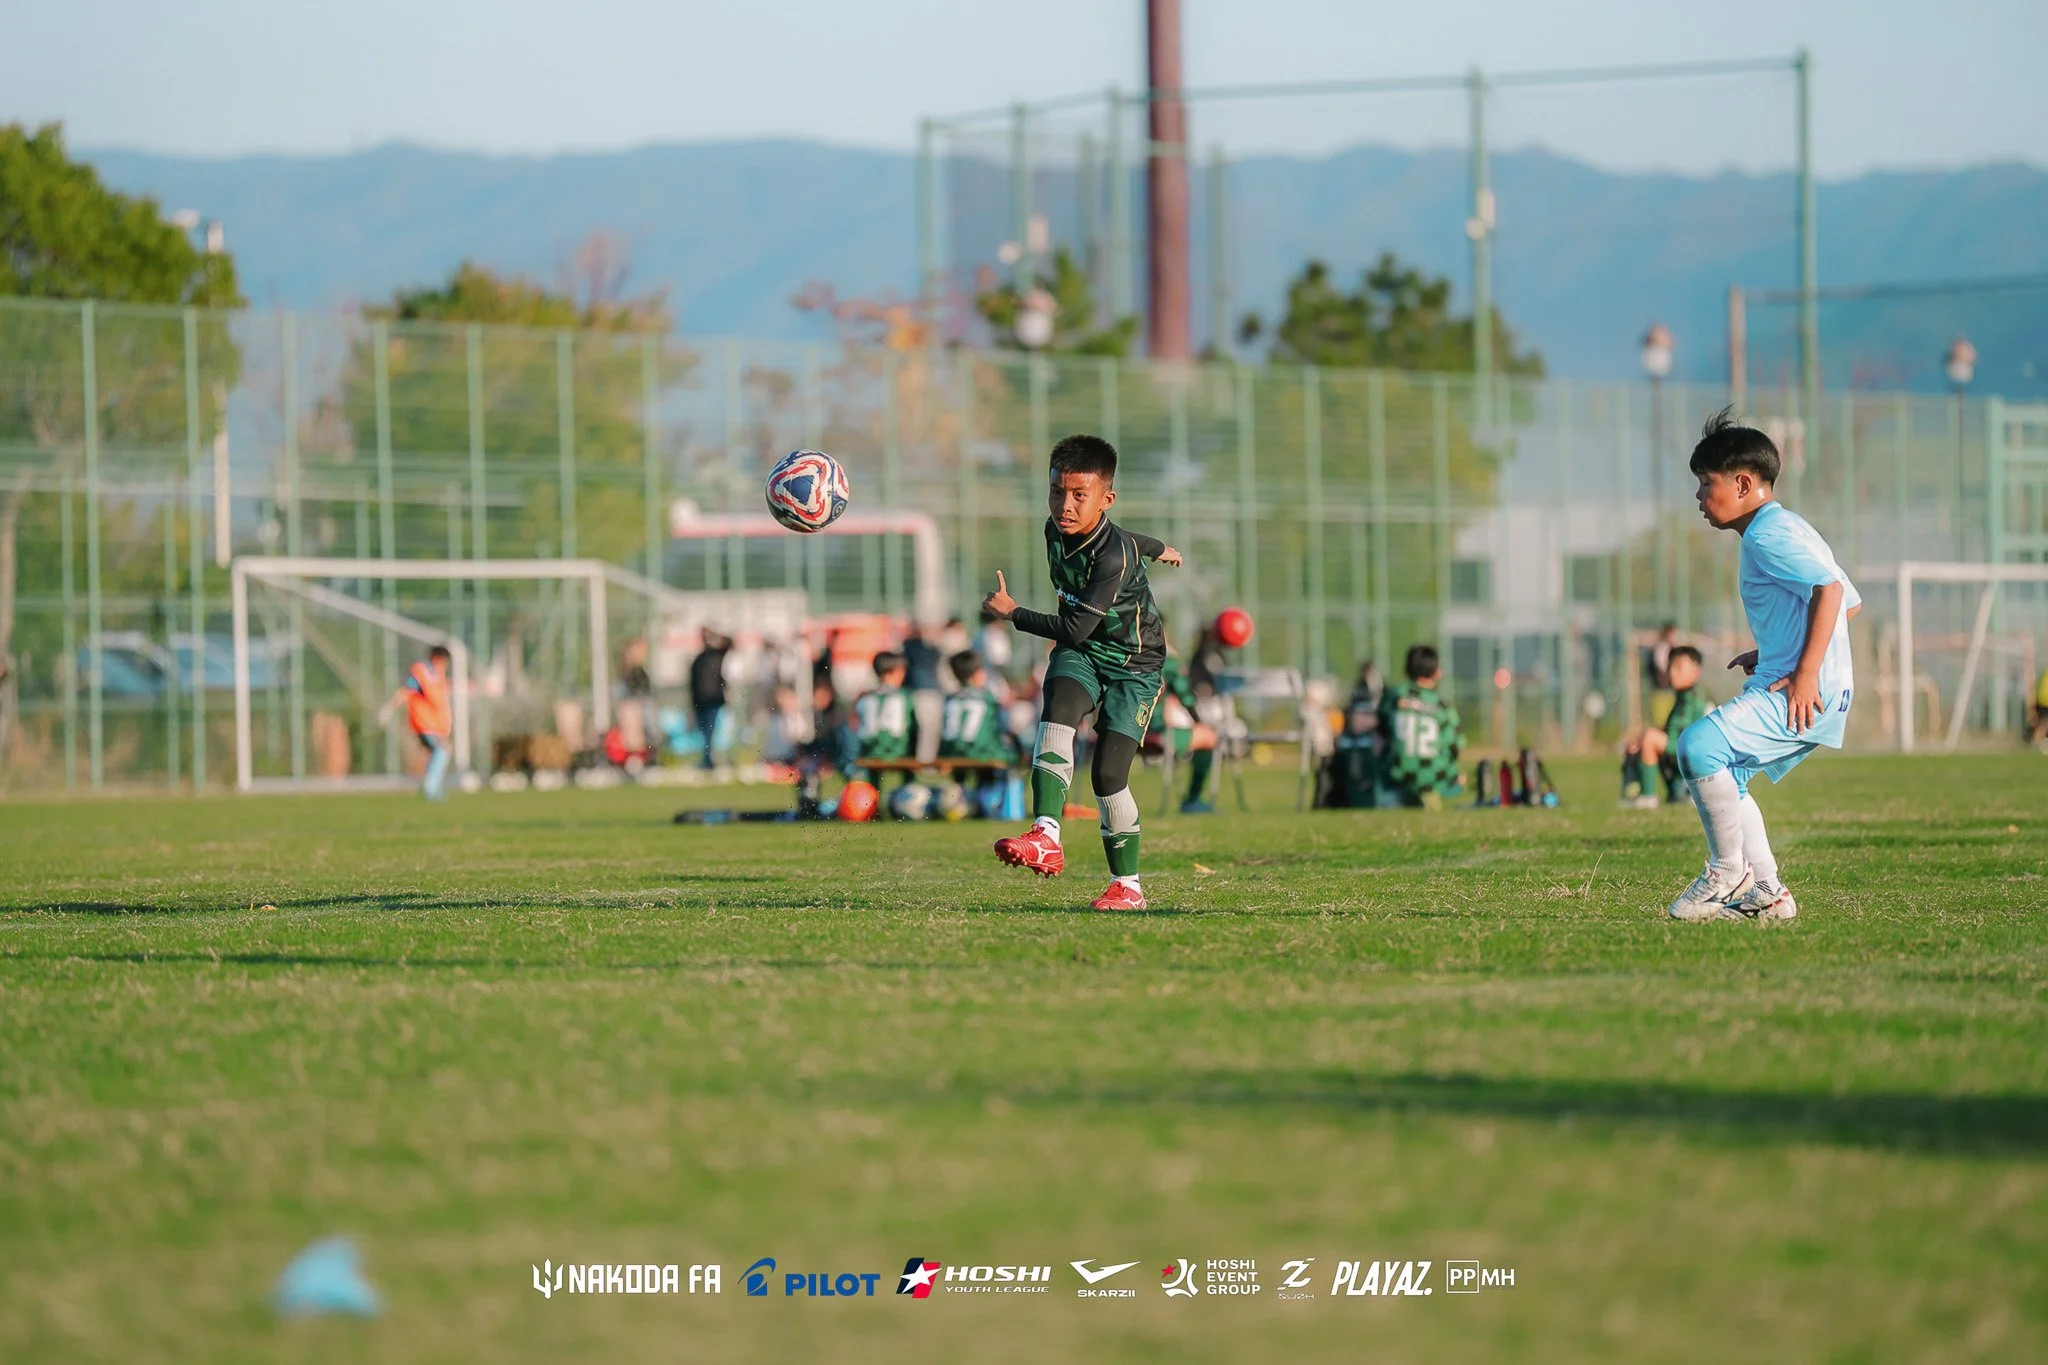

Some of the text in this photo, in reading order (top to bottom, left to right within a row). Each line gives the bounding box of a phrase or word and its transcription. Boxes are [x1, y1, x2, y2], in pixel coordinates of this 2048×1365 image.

[856, 694, 906, 738] 14
[943, 698, 986, 742] 17
[1396, 712, 1440, 758] 12
